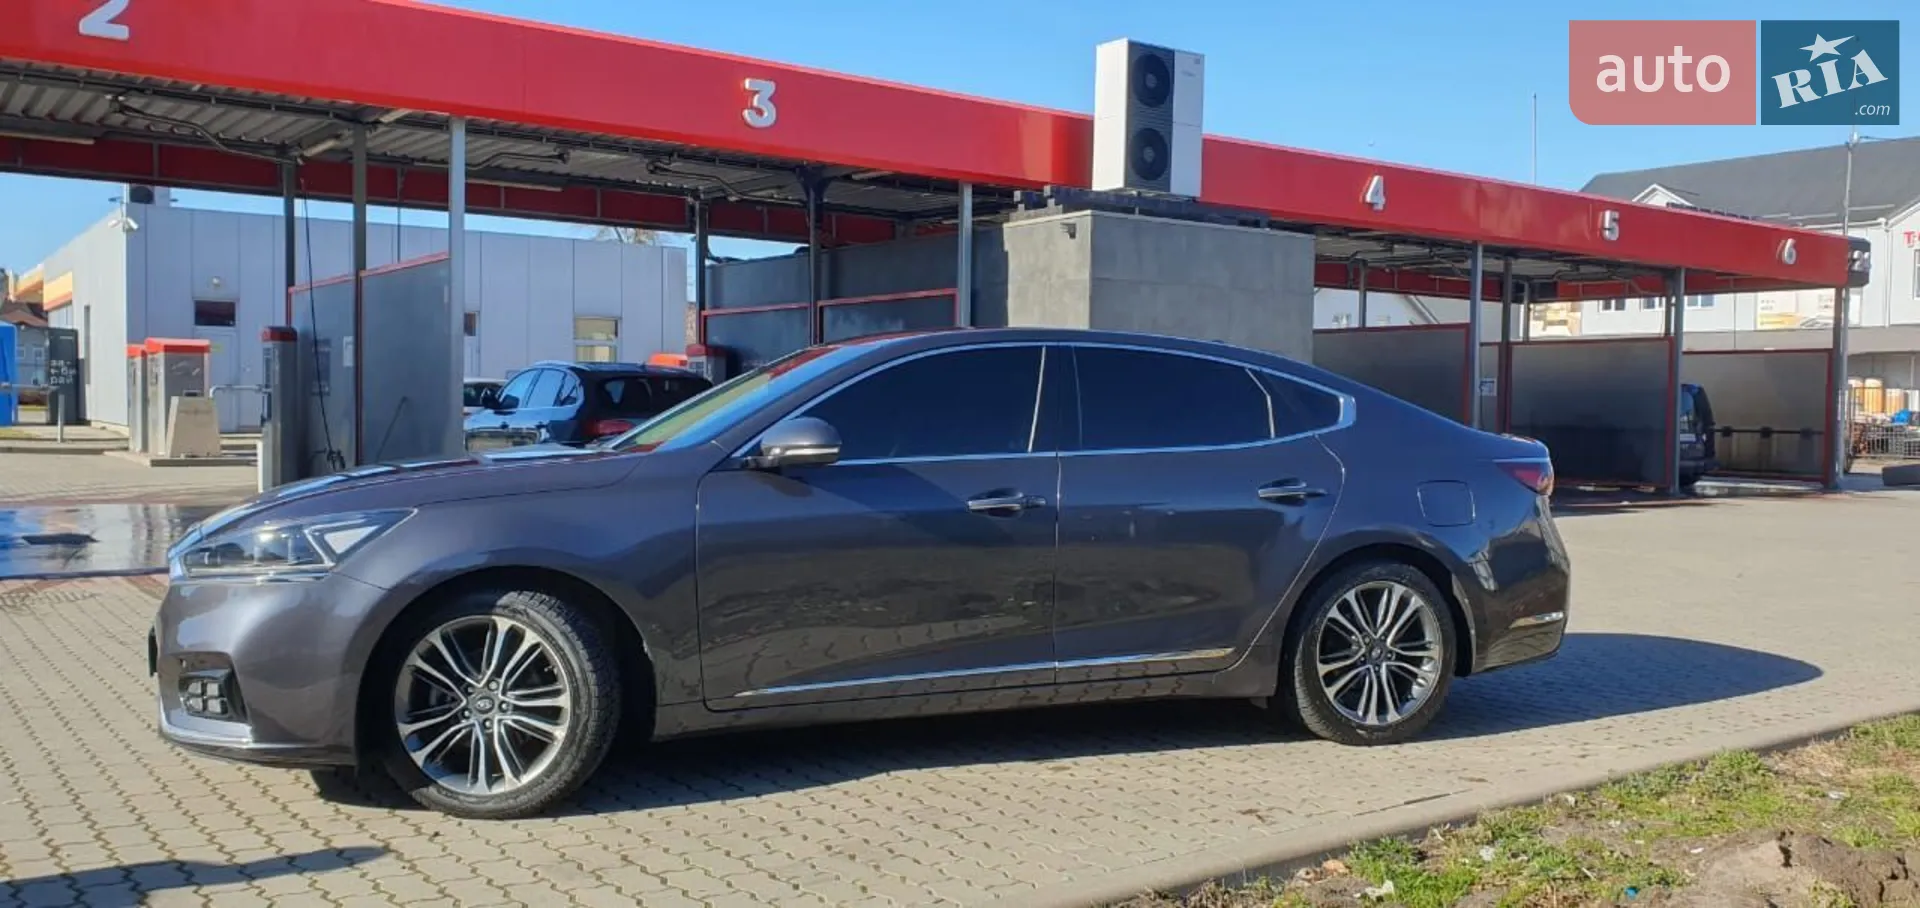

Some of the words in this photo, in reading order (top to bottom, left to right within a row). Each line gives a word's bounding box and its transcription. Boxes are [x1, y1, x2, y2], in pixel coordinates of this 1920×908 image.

[742, 78, 777, 128] 3
[1366, 175, 1386, 211] 4
[1603, 209, 1620, 241] 5
[1782, 238, 1797, 265] 6
